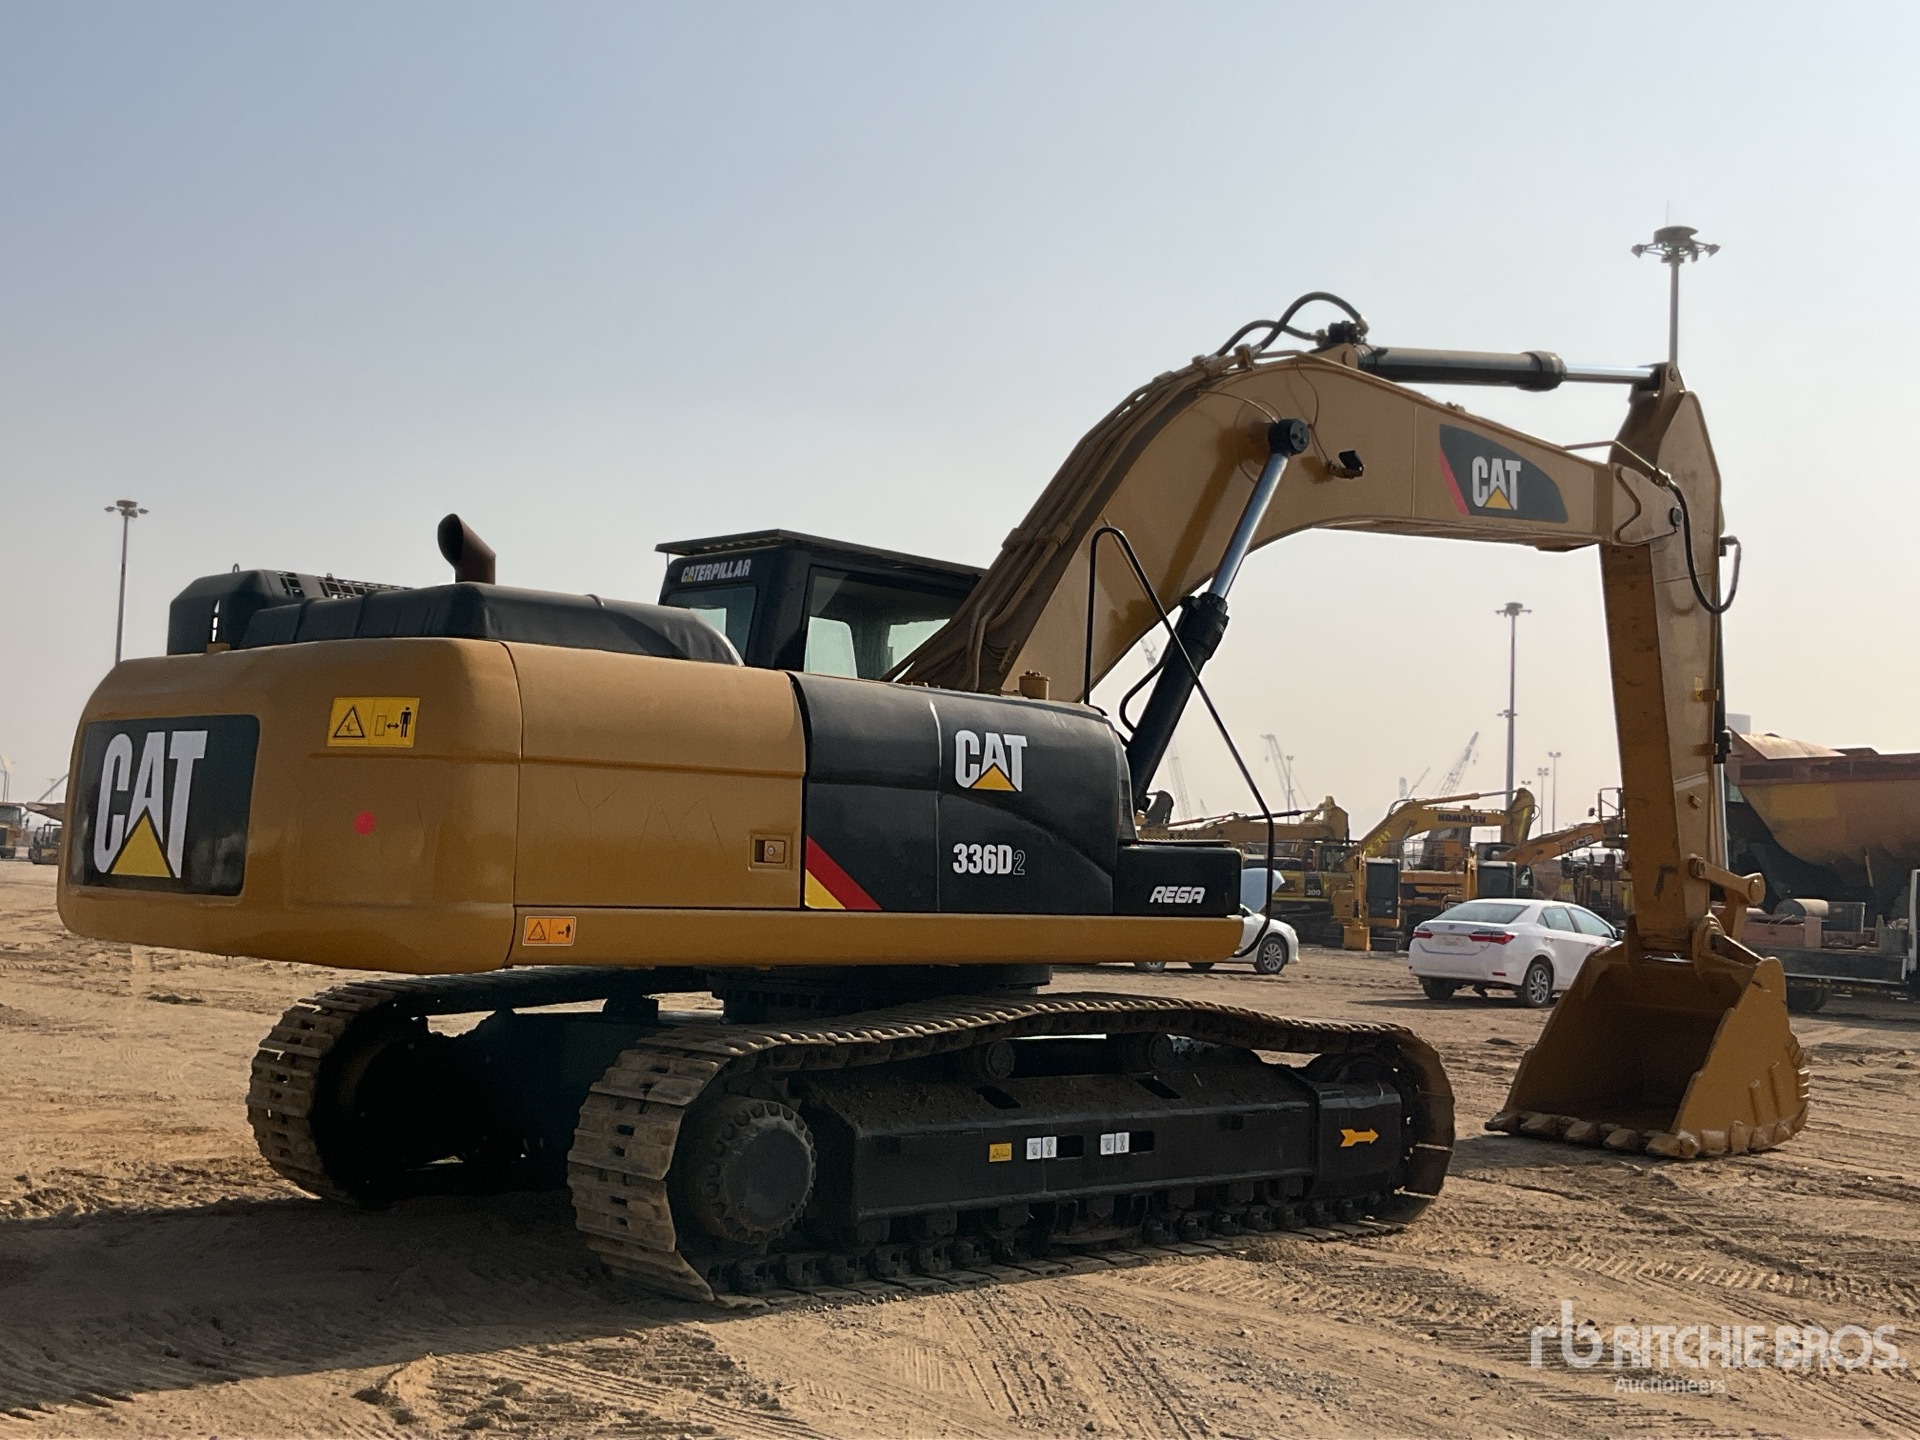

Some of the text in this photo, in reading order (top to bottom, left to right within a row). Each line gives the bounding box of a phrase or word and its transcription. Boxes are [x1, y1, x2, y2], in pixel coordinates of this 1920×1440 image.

[1472, 456, 1521, 510] CAT
[681, 559, 752, 583] CATERPILLAR
[955, 729, 1028, 792] CAT
[93, 729, 208, 879] CAT
[1437, 813, 1487, 824] KOMATSU
[952, 843, 1026, 876] 336D2
[1149, 886, 1206, 904] REGA
